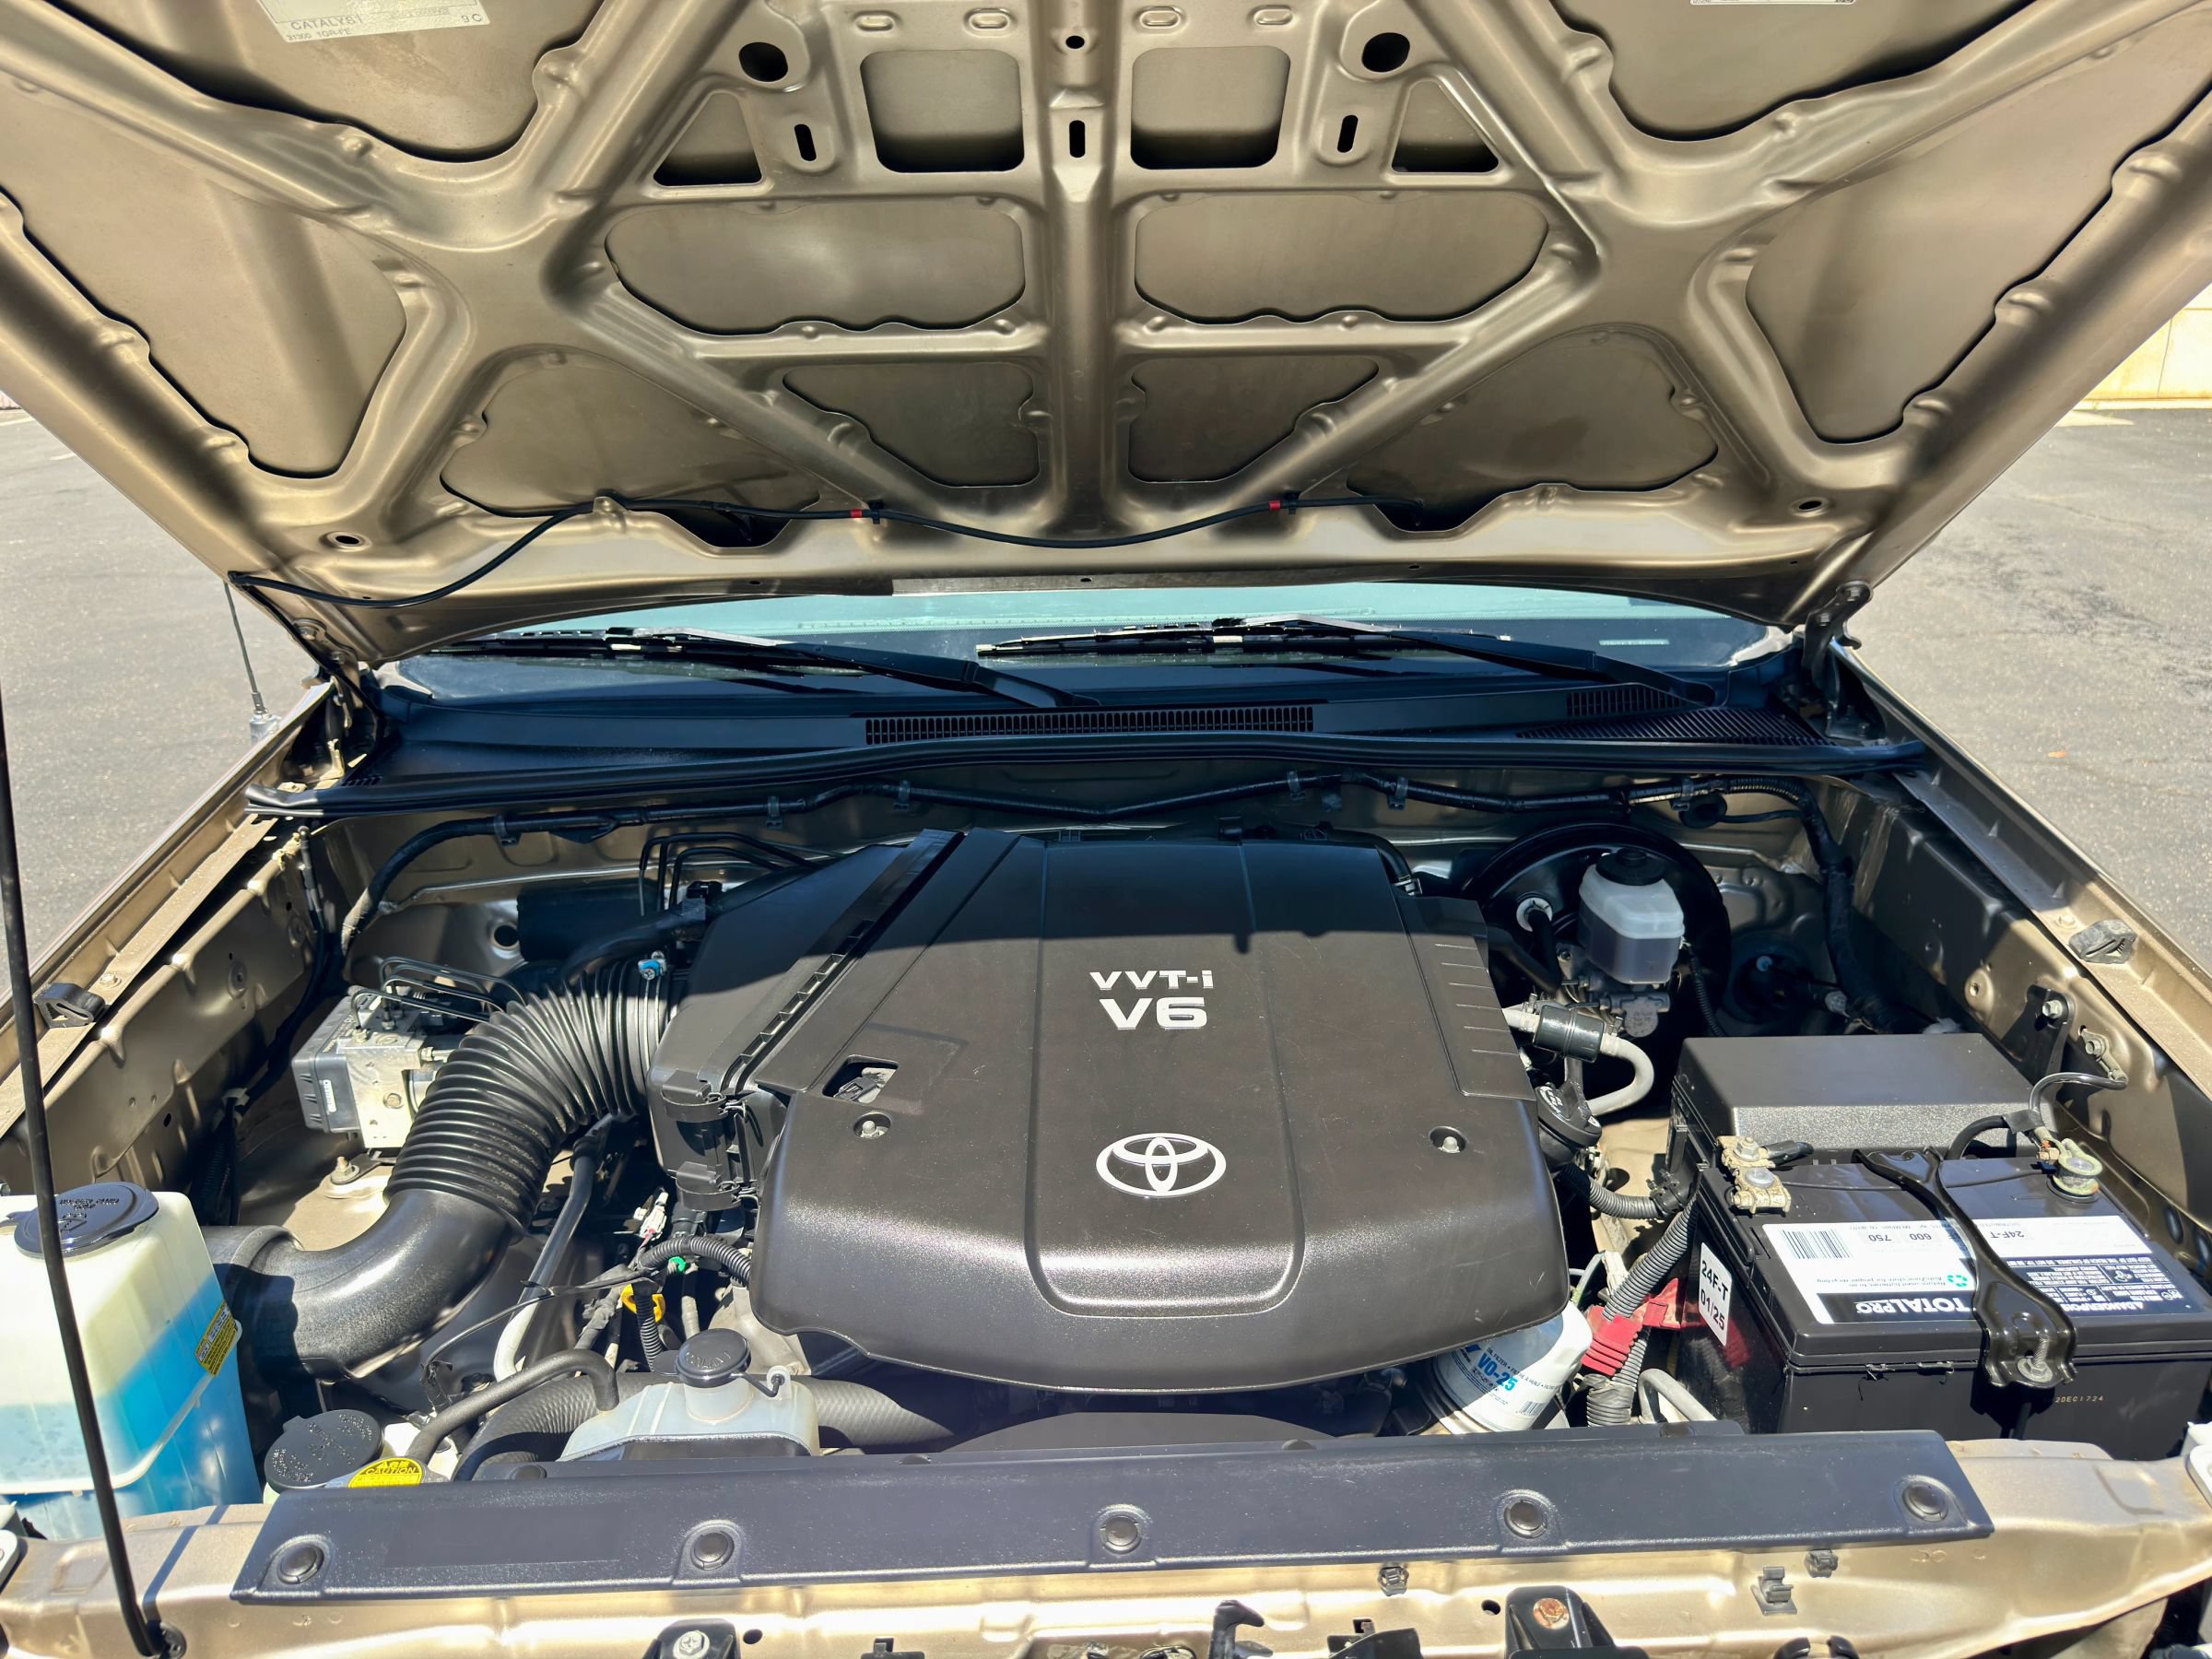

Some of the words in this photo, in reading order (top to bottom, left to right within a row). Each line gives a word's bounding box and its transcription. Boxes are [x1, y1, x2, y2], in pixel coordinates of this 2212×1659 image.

[1089, 970, 1214, 990] VVT-i
[1099, 997, 1207, 1030] V6
[1701, 1260, 1728, 1301] 24F-T
[1700, 1288, 1725, 1330] 01/25
[1856, 1298, 1971, 1313] TOTALPRO
[1477, 1352, 1518, 1391] VO-25
[1493, 1353, 1508, 1368] FILTER
